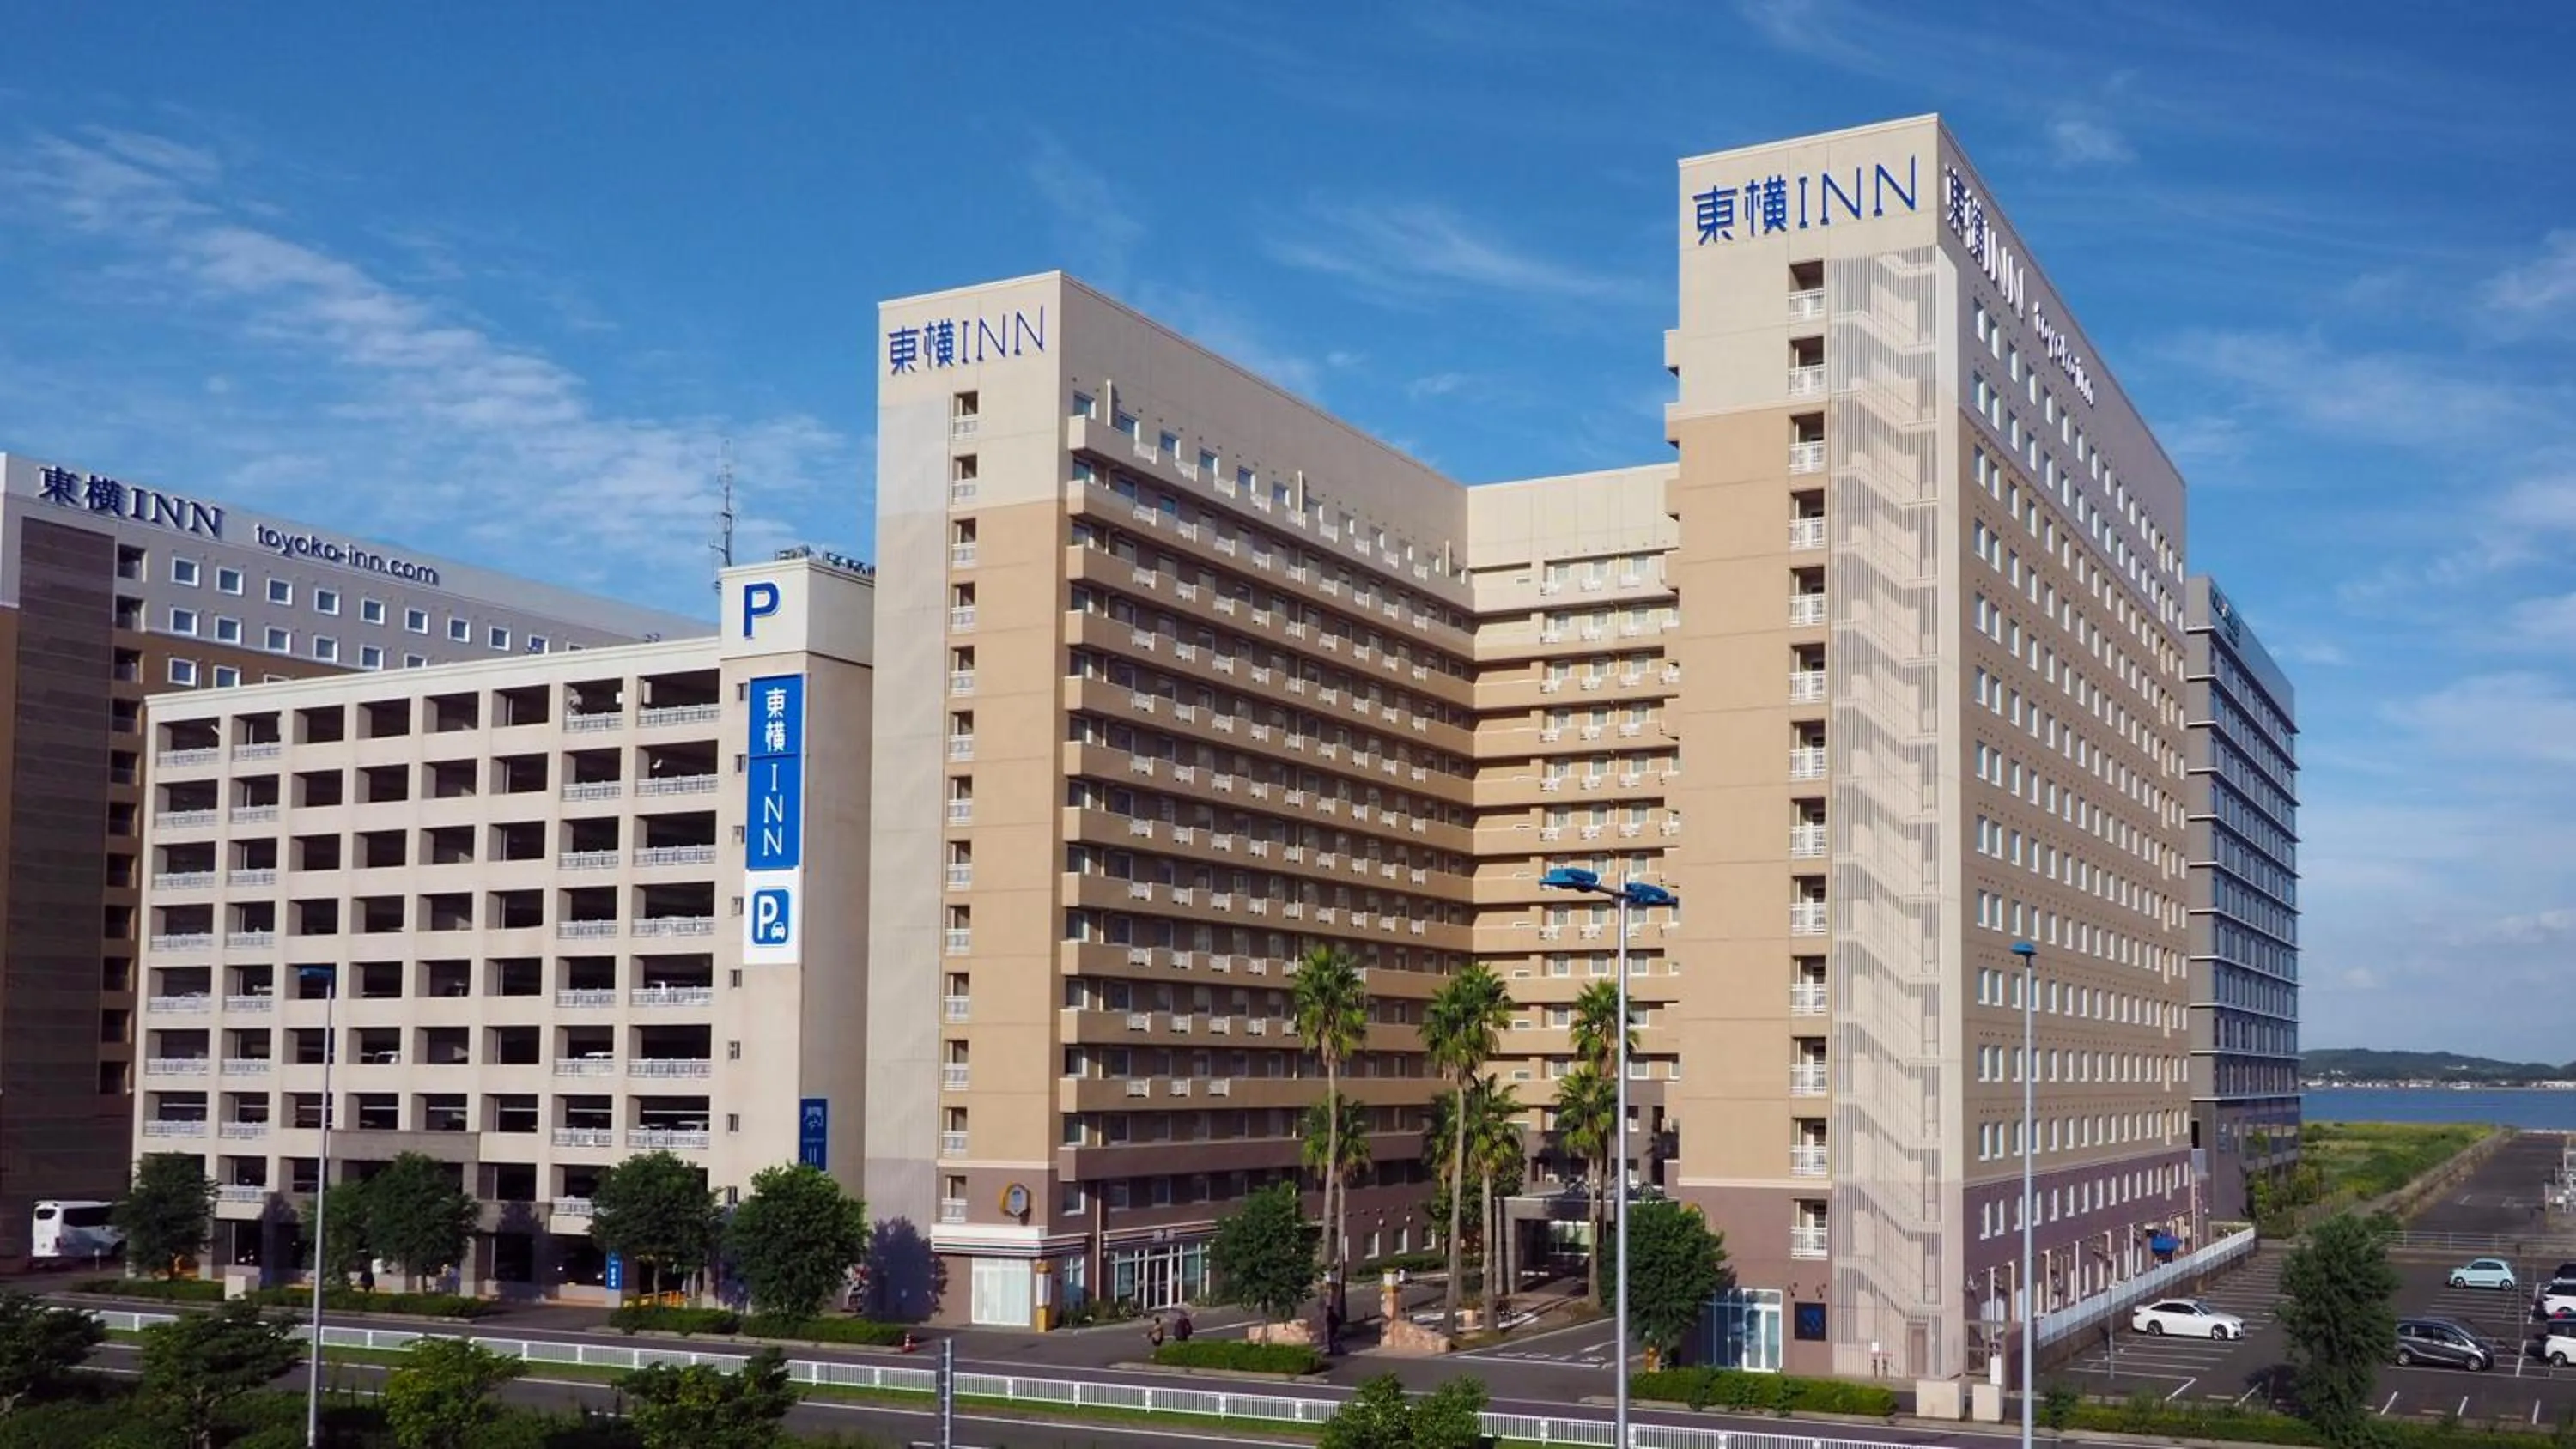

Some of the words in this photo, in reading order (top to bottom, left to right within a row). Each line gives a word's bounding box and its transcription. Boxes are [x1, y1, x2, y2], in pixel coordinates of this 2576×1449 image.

[1692, 154, 1917, 246] 東横INN
[888, 305, 1045, 376] 東横INN
[38, 464, 226, 539] 東横INN
[254, 522, 440, 585] toyoko-inn.com
[743, 581, 781, 638] P
[763, 687, 787, 856] 東横INN
[757, 895, 778, 940] P
